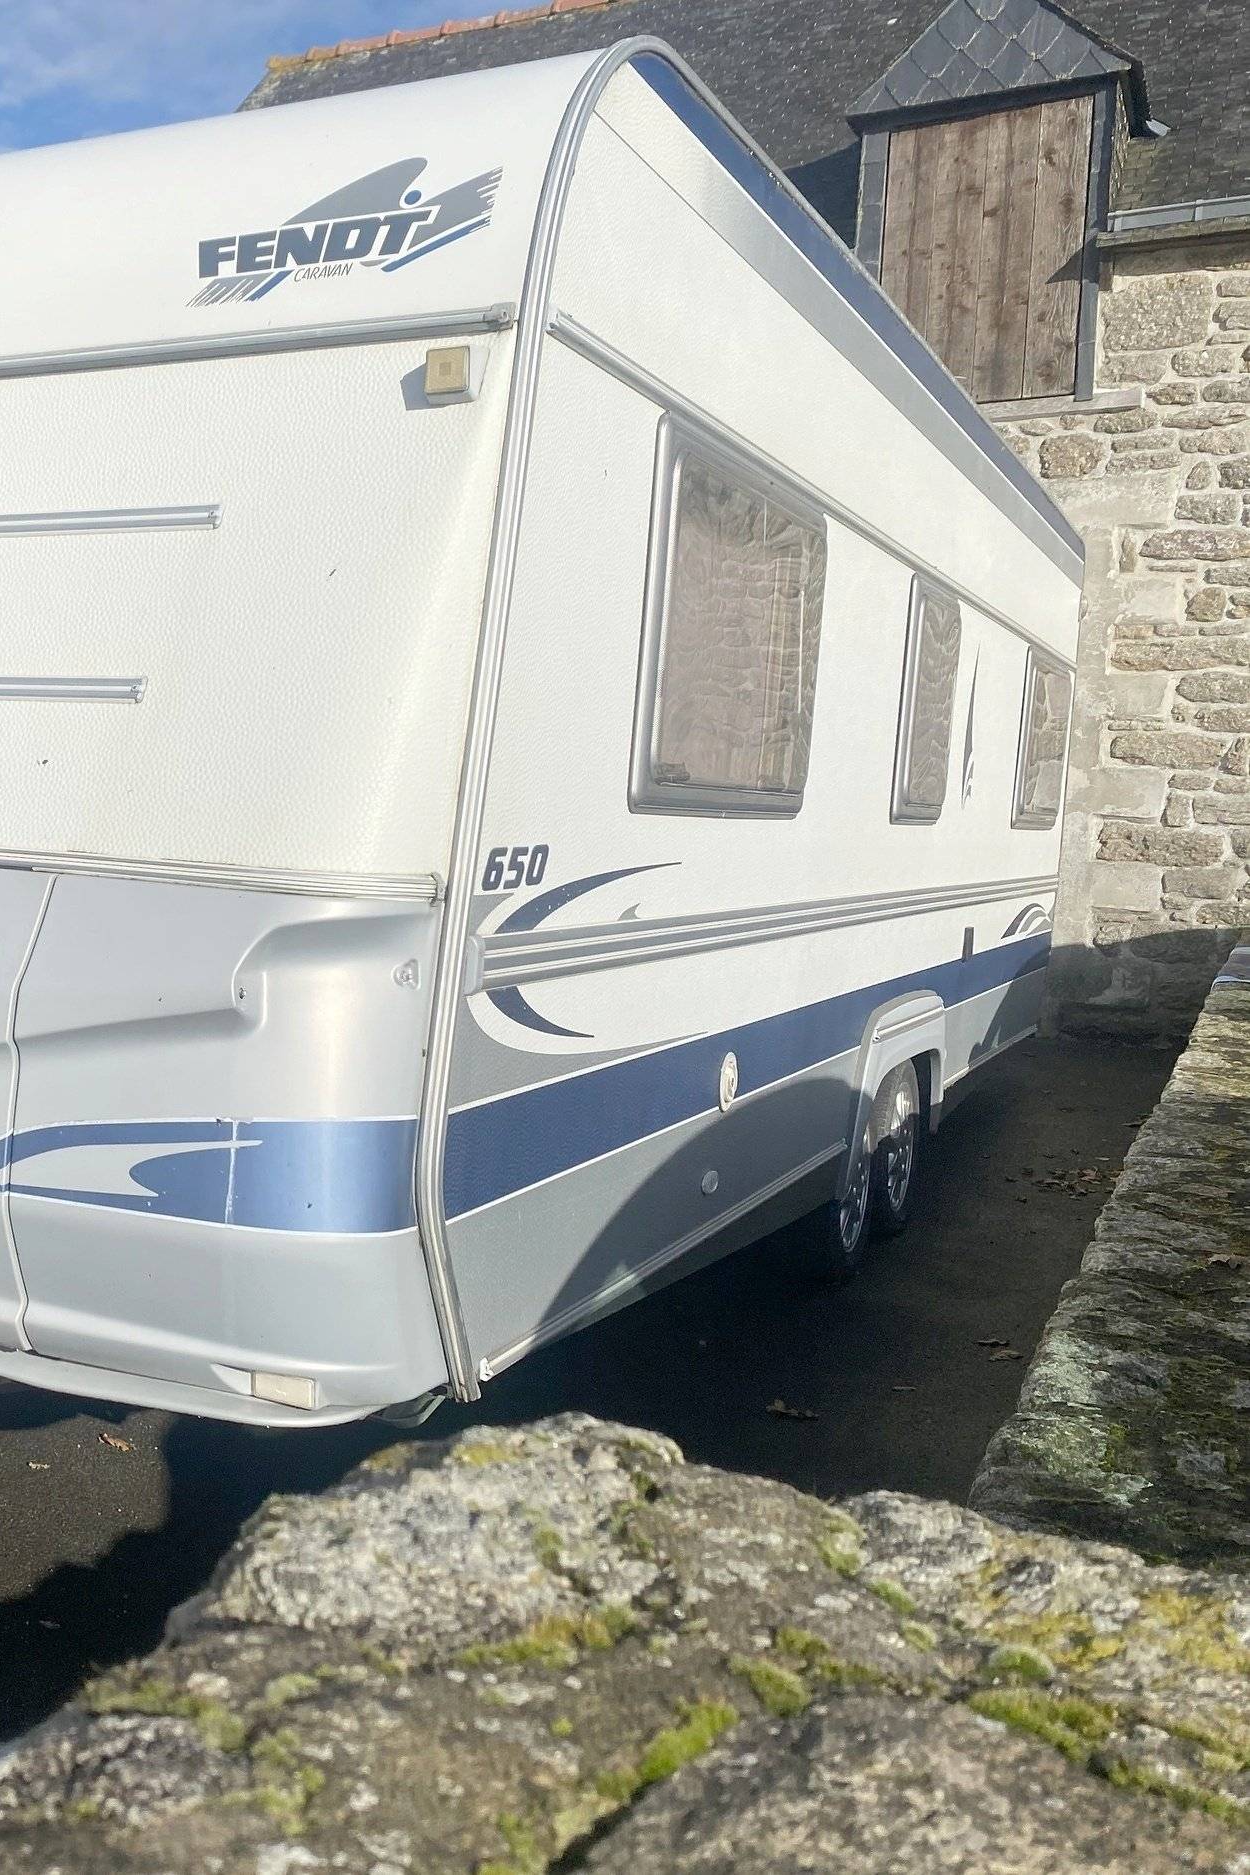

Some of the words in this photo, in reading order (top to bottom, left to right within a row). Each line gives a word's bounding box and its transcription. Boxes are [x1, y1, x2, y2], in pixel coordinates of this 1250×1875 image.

[199, 209, 431, 279] FENDT
[294, 262, 354, 282] CARAVAN
[481, 844, 550, 891] 650
